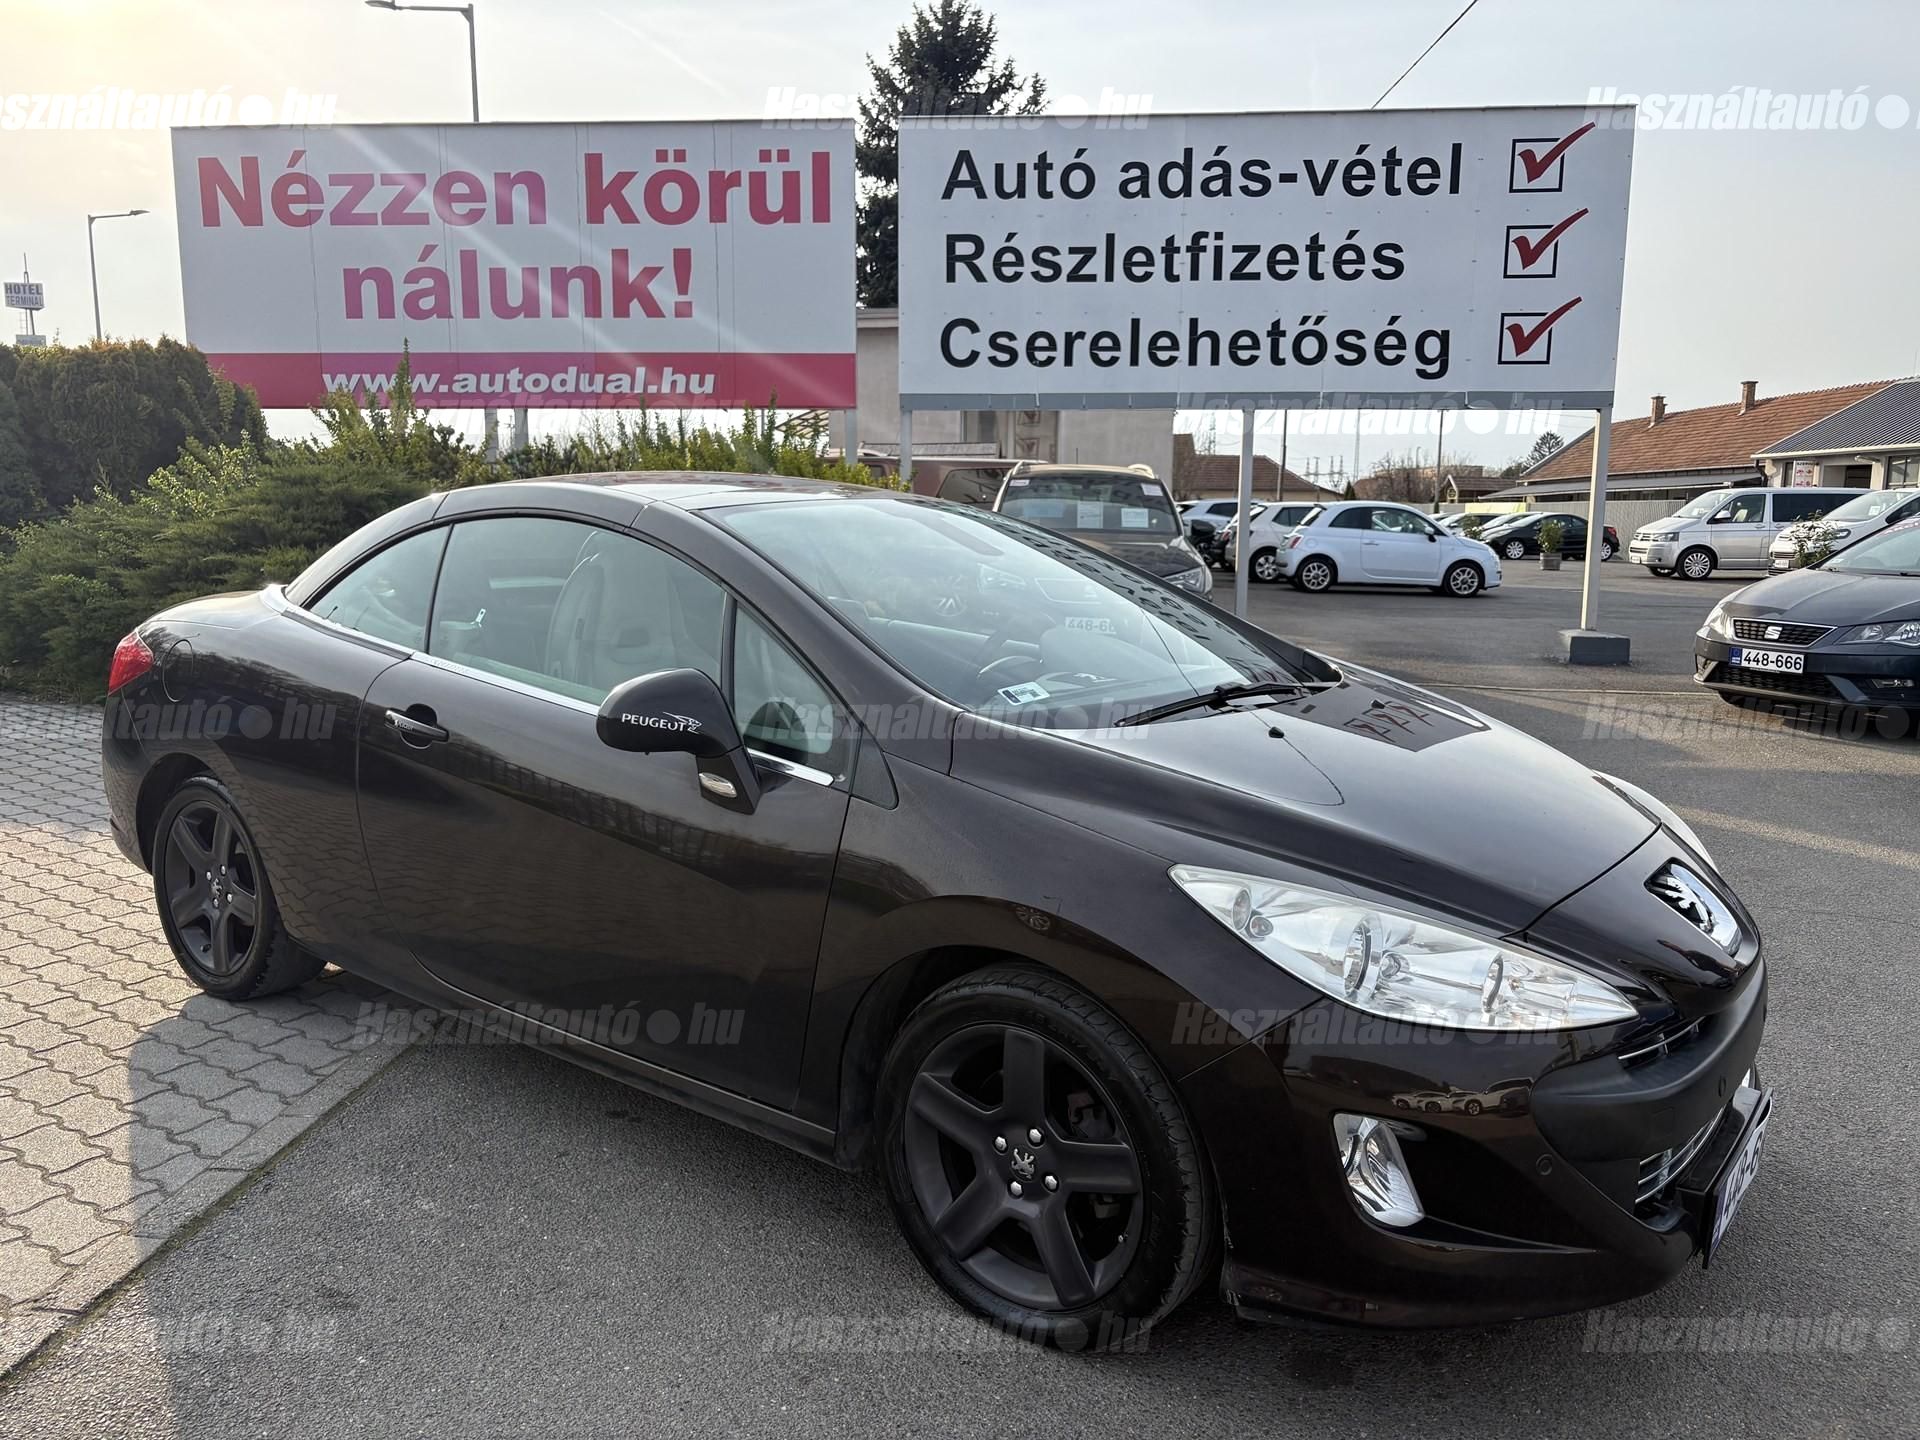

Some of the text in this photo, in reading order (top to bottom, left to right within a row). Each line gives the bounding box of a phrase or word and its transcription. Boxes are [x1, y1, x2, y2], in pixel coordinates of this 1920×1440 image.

[197, 149, 831, 227] Nézzen körül
[941, 143, 1462, 200] Autó adás-vétel
[342, 244, 693, 320] nálunk!
[945, 229, 1405, 283] Részletfizetés
[5, 284, 43, 295] HOTEL
[940, 315, 1451, 380] Cserelehetőség
[322, 366, 716, 394] www.autodual.hu
[1743, 651, 1803, 671] 448-666
[621, 713, 688, 732] PEUGEOT
